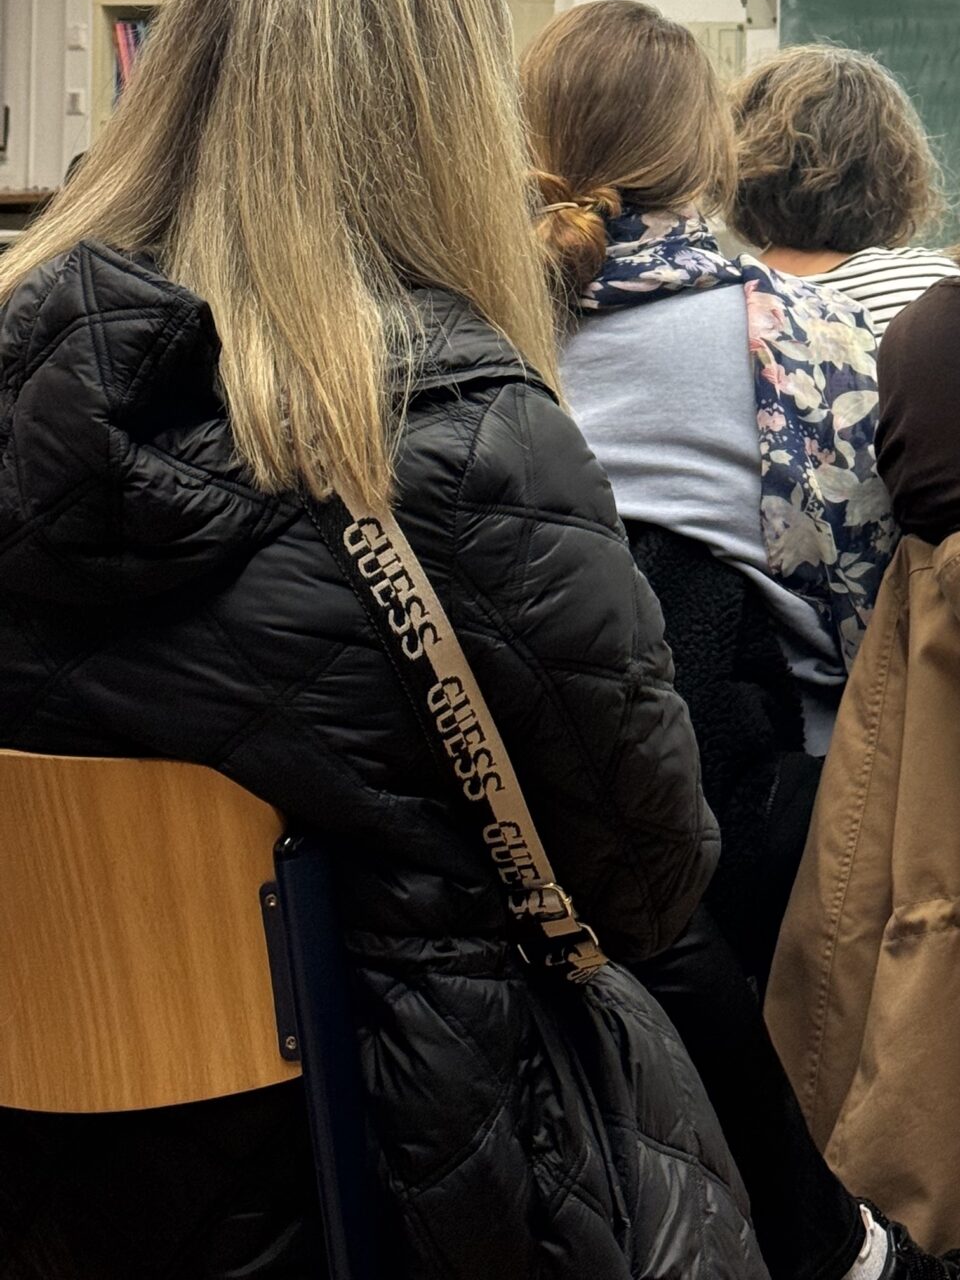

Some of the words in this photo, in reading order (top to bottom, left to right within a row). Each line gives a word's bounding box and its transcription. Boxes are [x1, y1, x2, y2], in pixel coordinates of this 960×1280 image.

[343, 517, 443, 661] GUESS
[426, 676, 506, 802] GUESS
[483, 820, 548, 919] GUES
